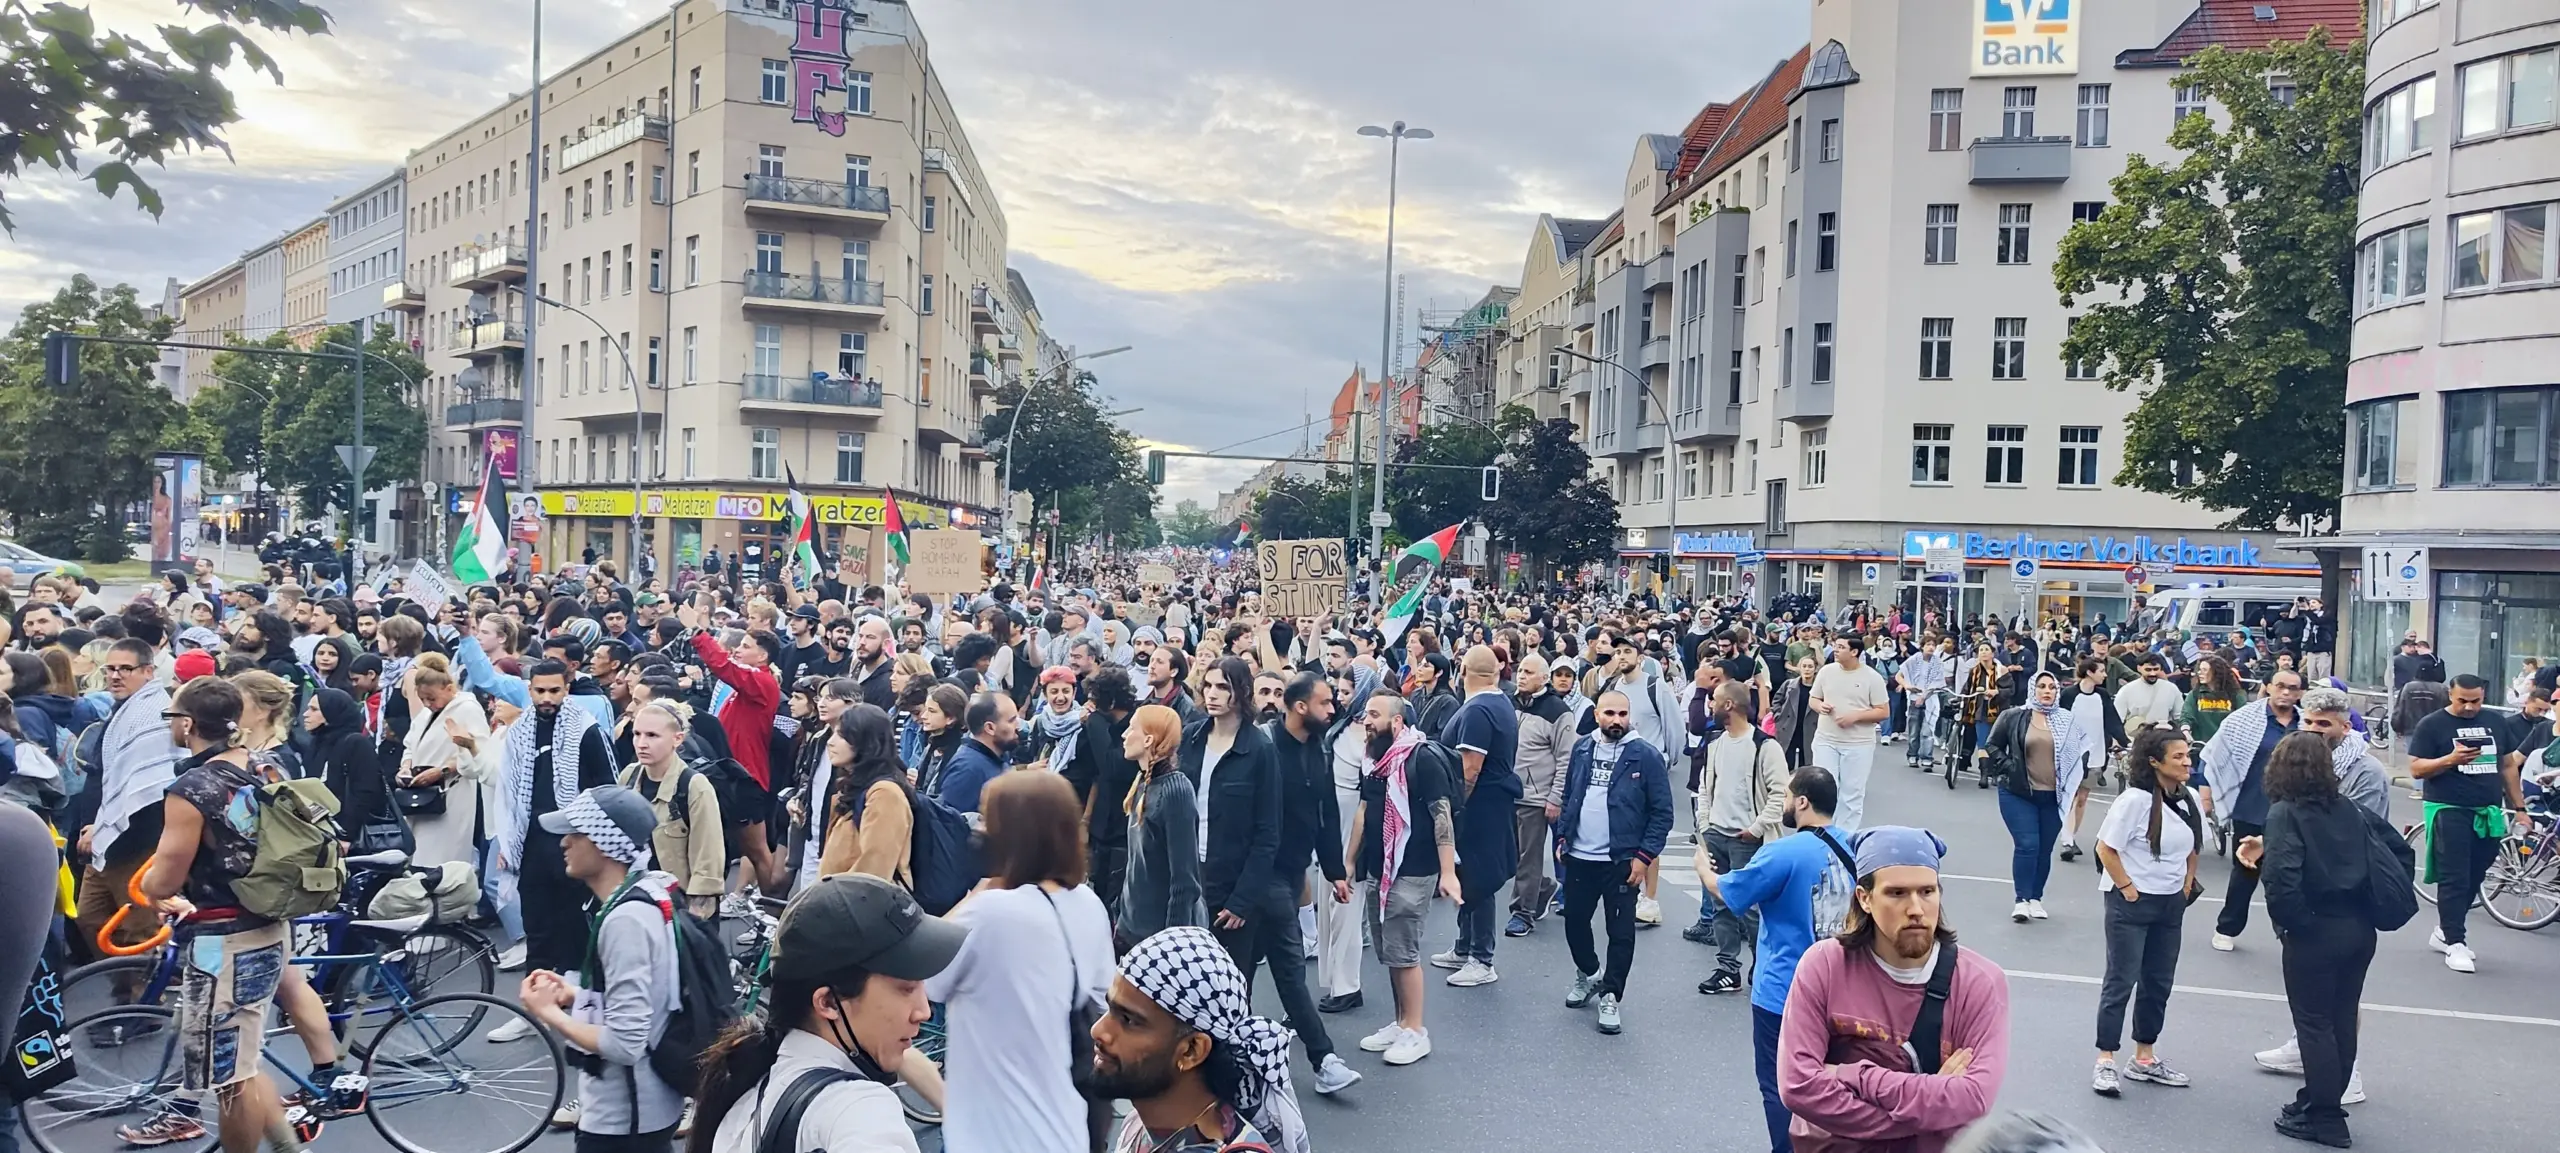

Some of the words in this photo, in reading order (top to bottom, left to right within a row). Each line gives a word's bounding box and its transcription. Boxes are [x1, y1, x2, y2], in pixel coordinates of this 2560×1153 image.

[1982, 37, 2065, 66] Bank
[578, 495, 616, 514] Matratzen
[664, 494, 712, 516] Matratzen
[720, 496, 764, 516] MFO
[843, 544, 867, 562] SAVE
[930, 537, 958, 550] STOP
[1965, 531, 2088, 561] Berliner
[2089, 535, 2261, 567] Volksbank
[921, 551, 968, 564] BOMBING
[1291, 542, 1342, 580] FOR
[841, 559, 866, 577] GAZA
[927, 566, 960, 578] RAFAH
[1265, 583, 1345, 617] STINE
[2457, 727, 2487, 738] FREE
